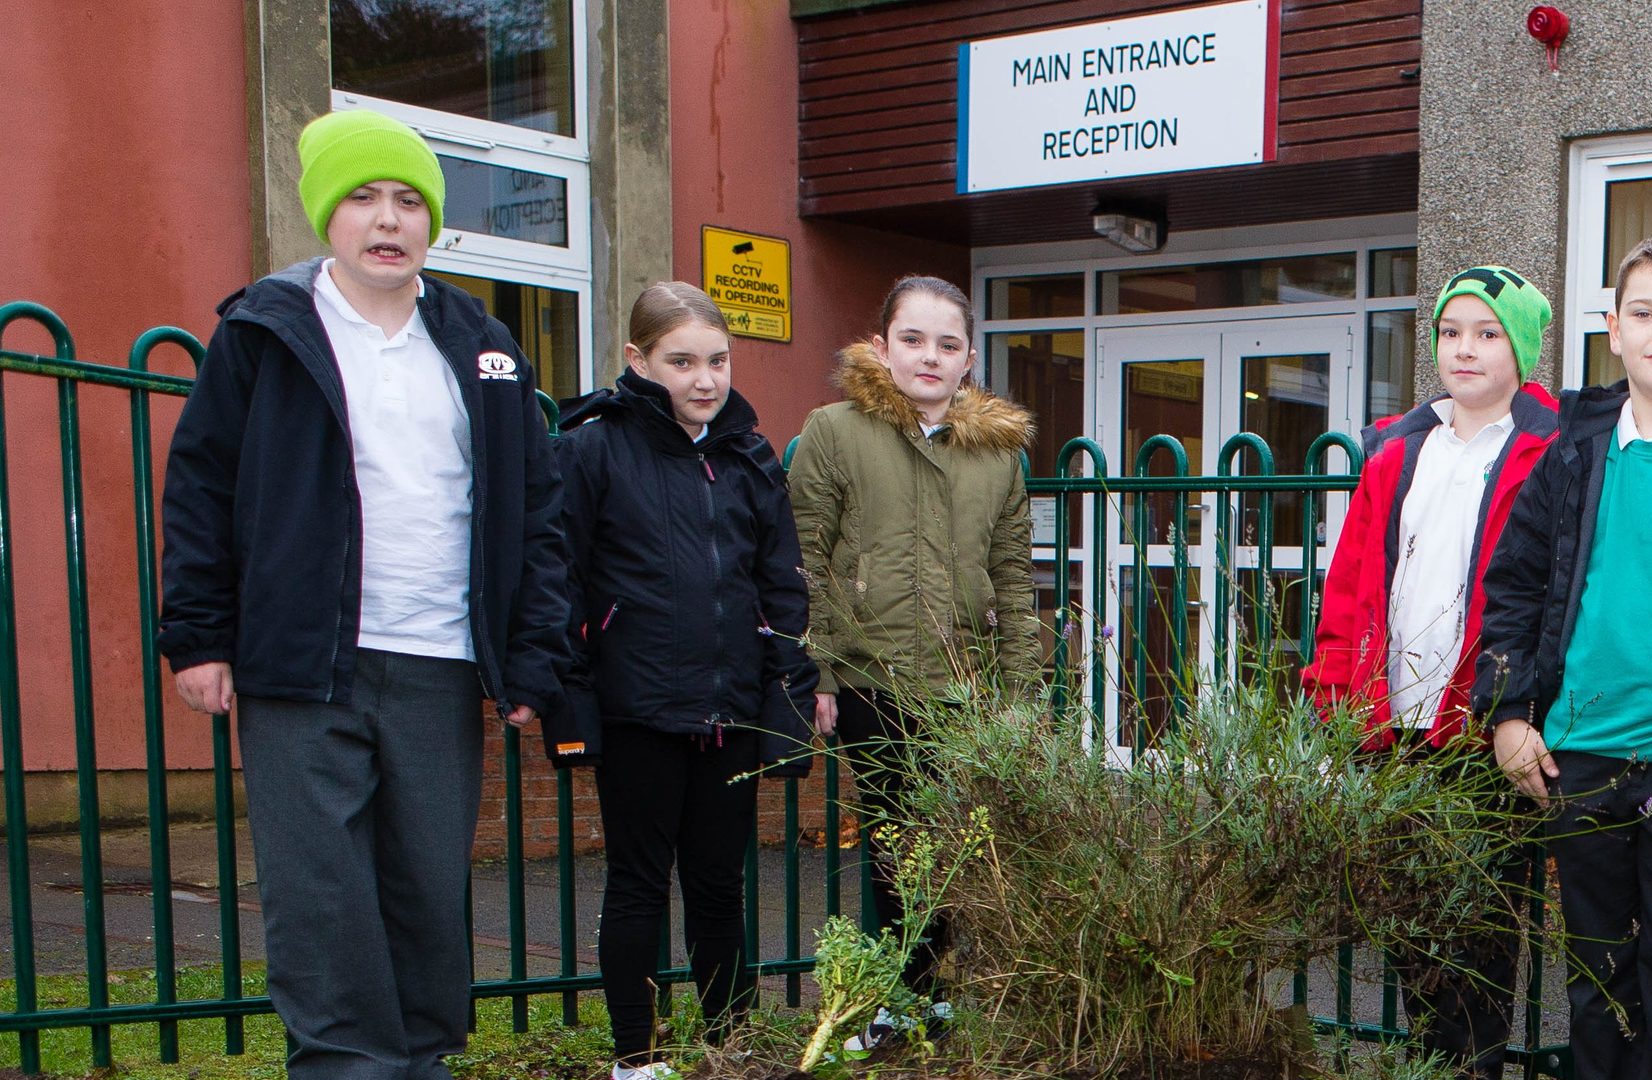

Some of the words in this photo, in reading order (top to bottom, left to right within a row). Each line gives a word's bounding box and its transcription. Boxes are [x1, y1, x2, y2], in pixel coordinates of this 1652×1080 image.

[1012, 53, 1072, 87] MAIN
[1082, 33, 1217, 79] ENTRANCE
[1084, 84, 1137, 117] AND
[1042, 117, 1179, 161] RECEPTION
[732, 264, 762, 278] CCTV
[710, 287, 721, 299] IN
[725, 289, 785, 309] OPERATION
[715, 275, 780, 295] RECORDING
